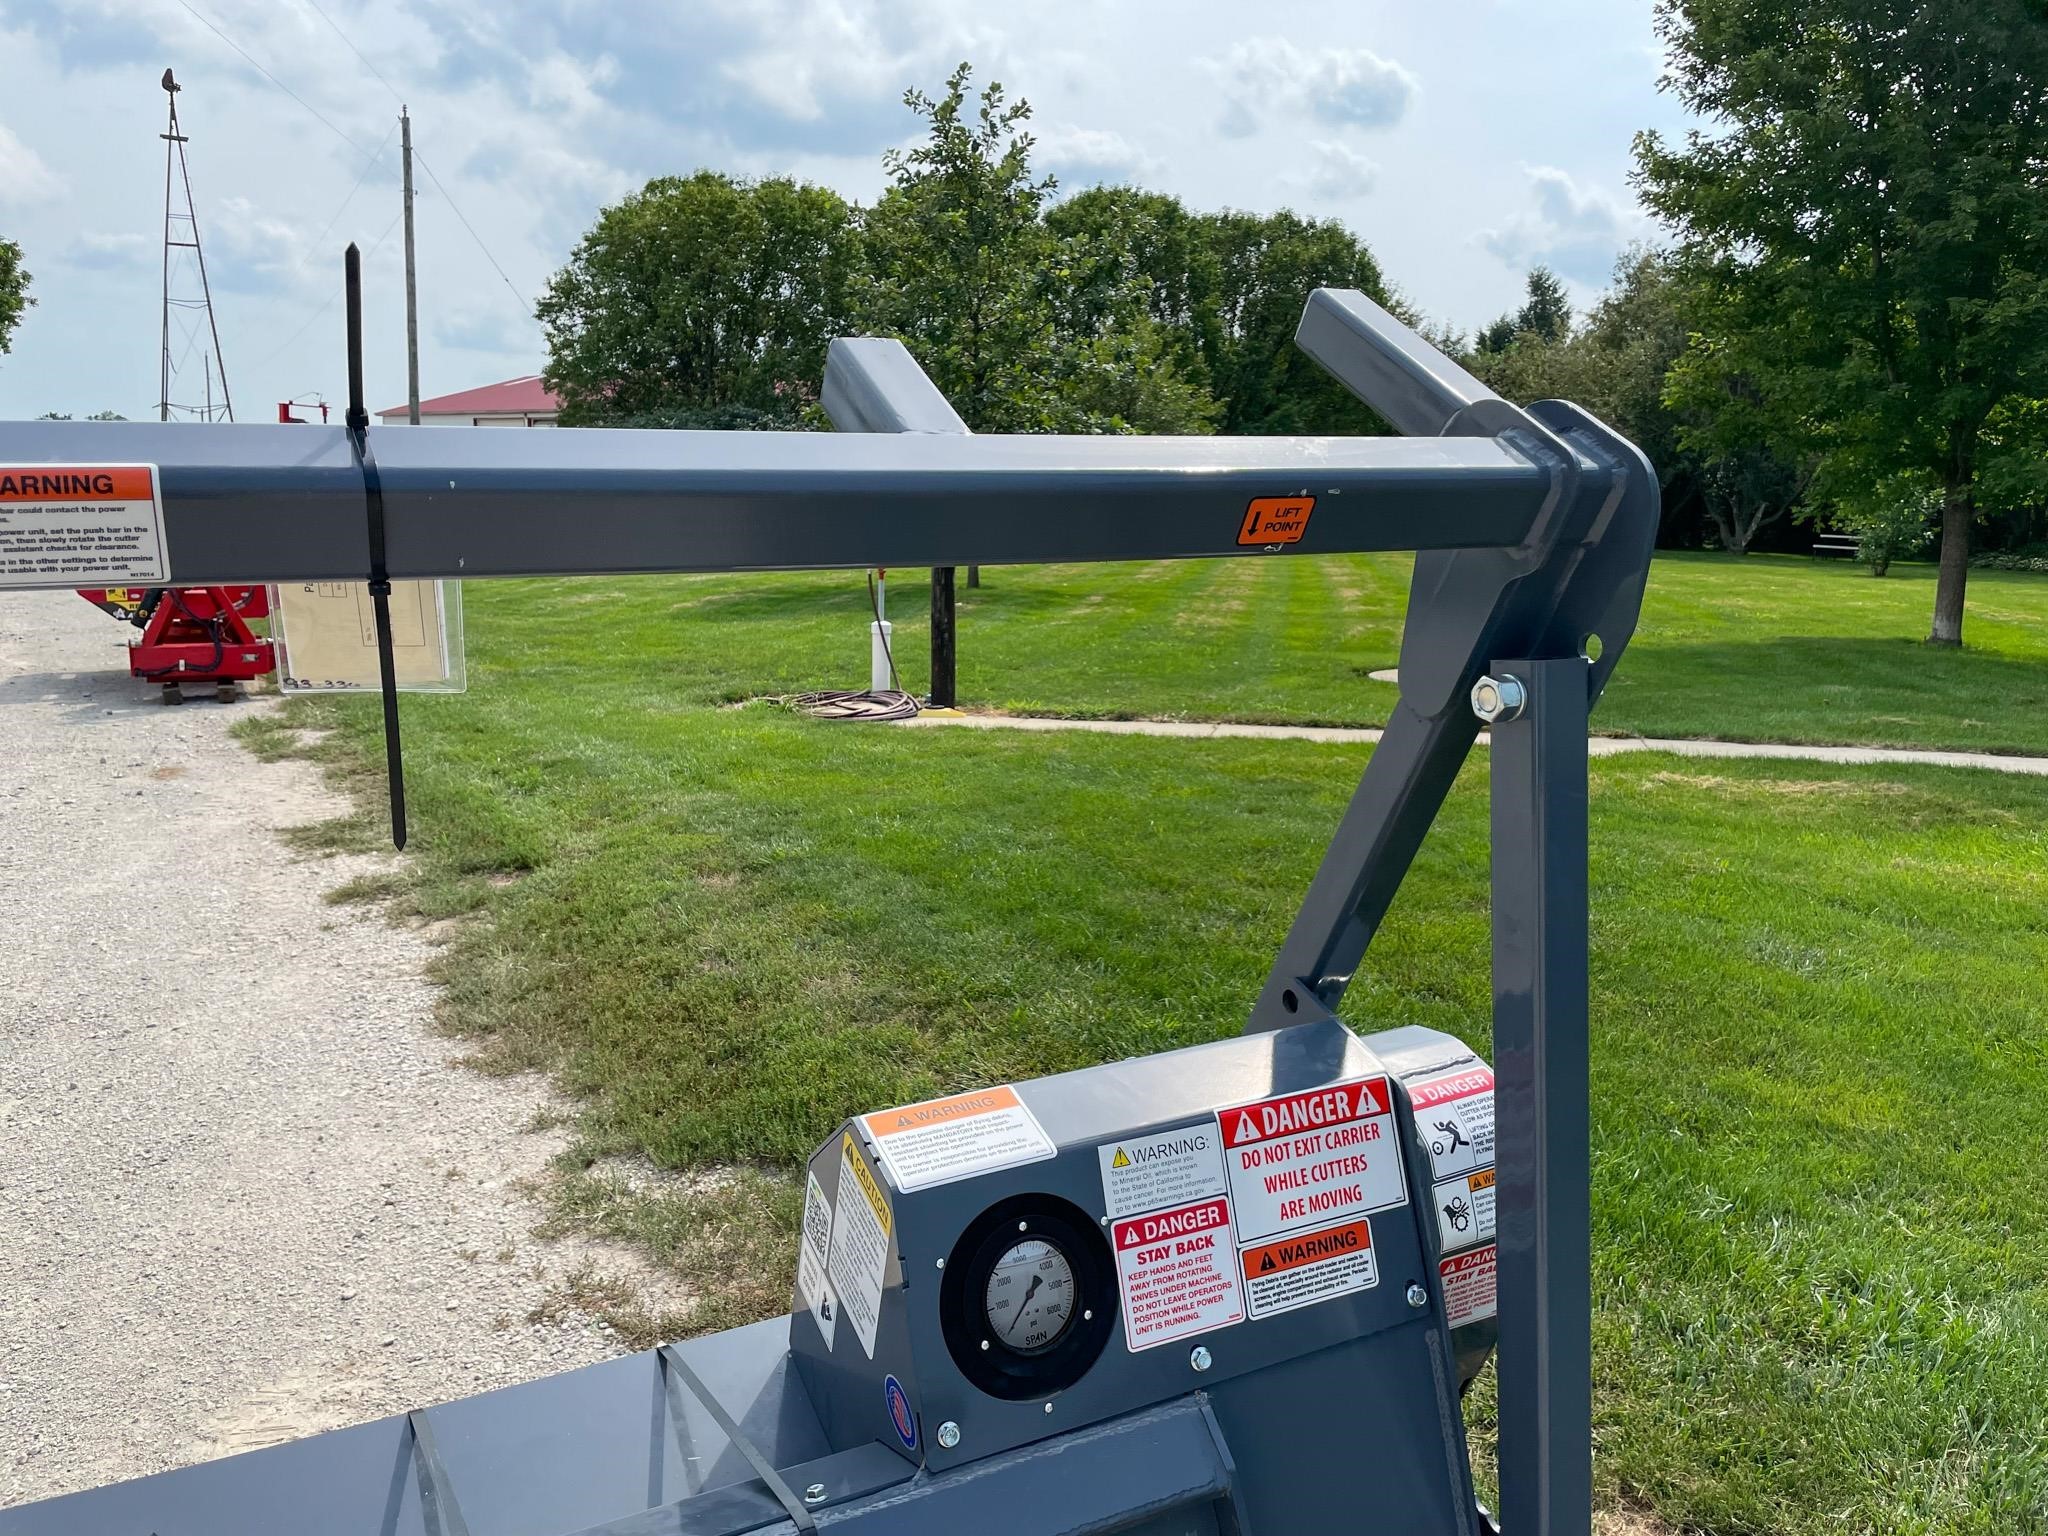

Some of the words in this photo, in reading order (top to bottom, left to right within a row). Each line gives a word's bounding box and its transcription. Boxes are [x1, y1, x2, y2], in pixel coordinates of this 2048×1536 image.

[1275, 508, 1303, 518] LIFT
[1264, 521, 1302, 532] POINT
[1424, 1075, 1490, 1100] DANGER
[914, 1097, 995, 1121] WARNING
[1262, 1091, 1351, 1136] DANGER
[1457, 1101, 1476, 1110] ALWAYS
[1460, 1108, 1479, 1116] CUTTER
[1469, 1123, 1488, 1132] LIFTING
[1472, 1132, 1486, 1140] BACK
[1132, 1136, 1210, 1164] WARNING:
[1241, 1149, 1260, 1170] DO
[1264, 1142, 1291, 1164] NOT
[1294, 1135, 1322, 1158] EXIT
[1325, 1122, 1380, 1149] CARRIER
[1476, 1145, 1493, 1154] FLYING
[1120, 1175, 1141, 1184] Mineral
[1155, 1168, 1171, 1177] which
[1179, 1163, 1197, 1172] known
[1125, 1164, 1147, 1175] product
[1161, 1158, 1181, 1167] expose
[1183, 1156, 1193, 1164] you
[1264, 1168, 1309, 1194] WHILE
[1311, 1154, 1368, 1183] CUTTERS
[856, 1158, 888, 1224] CAUTION
[1132, 1183, 1147, 1191] State
[1156, 1175, 1183, 1186] California
[1280, 1199, 1306, 1220] ARE
[1309, 1184, 1362, 1213] MOVING
[1144, 1206, 1220, 1240] DANGER
[1137, 1245, 1171, 1265] STAY
[1176, 1235, 1215, 1255] BACK
[1279, 1231, 1357, 1264] WARNING
[1040, 1260, 1053, 1270] 4000
[1128, 1270, 1148, 1282] KEEP
[1150, 1263, 1176, 1276] HANDS
[1178, 1260, 1194, 1270] AND
[1196, 1254, 1213, 1265] FEET
[997, 1276, 1011, 1287] 2000
[1048, 1280, 1062, 1290] 5000
[1130, 1281, 1153, 1292] AWAY
[1153, 1273, 1174, 1286] FROM
[1177, 1265, 1213, 1280] ROTATING
[1131, 1290, 1158, 1303] KNIVES
[1160, 1282, 1186, 1295] UNDER
[1188, 1273, 1222, 1289] MACHINE
[1446, 1270, 1475, 1286] STAY
[996, 1299, 1009, 1310] 1000
[1133, 1305, 1144, 1313] DO
[1146, 1300, 1162, 1310] NOT
[1164, 1293, 1187, 1305] LEAVE
[1188, 1281, 1232, 1298] OPERATORS
[1134, 1309, 1170, 1324] POSITION
[1171, 1303, 1195, 1314] WHILE
[1197, 1294, 1224, 1308] POWER
[1136, 1324, 1153, 1335] UNIT
[1165, 1313, 1201, 1326] RUNNING.
[1026, 1331, 1047, 1346] SPAN
